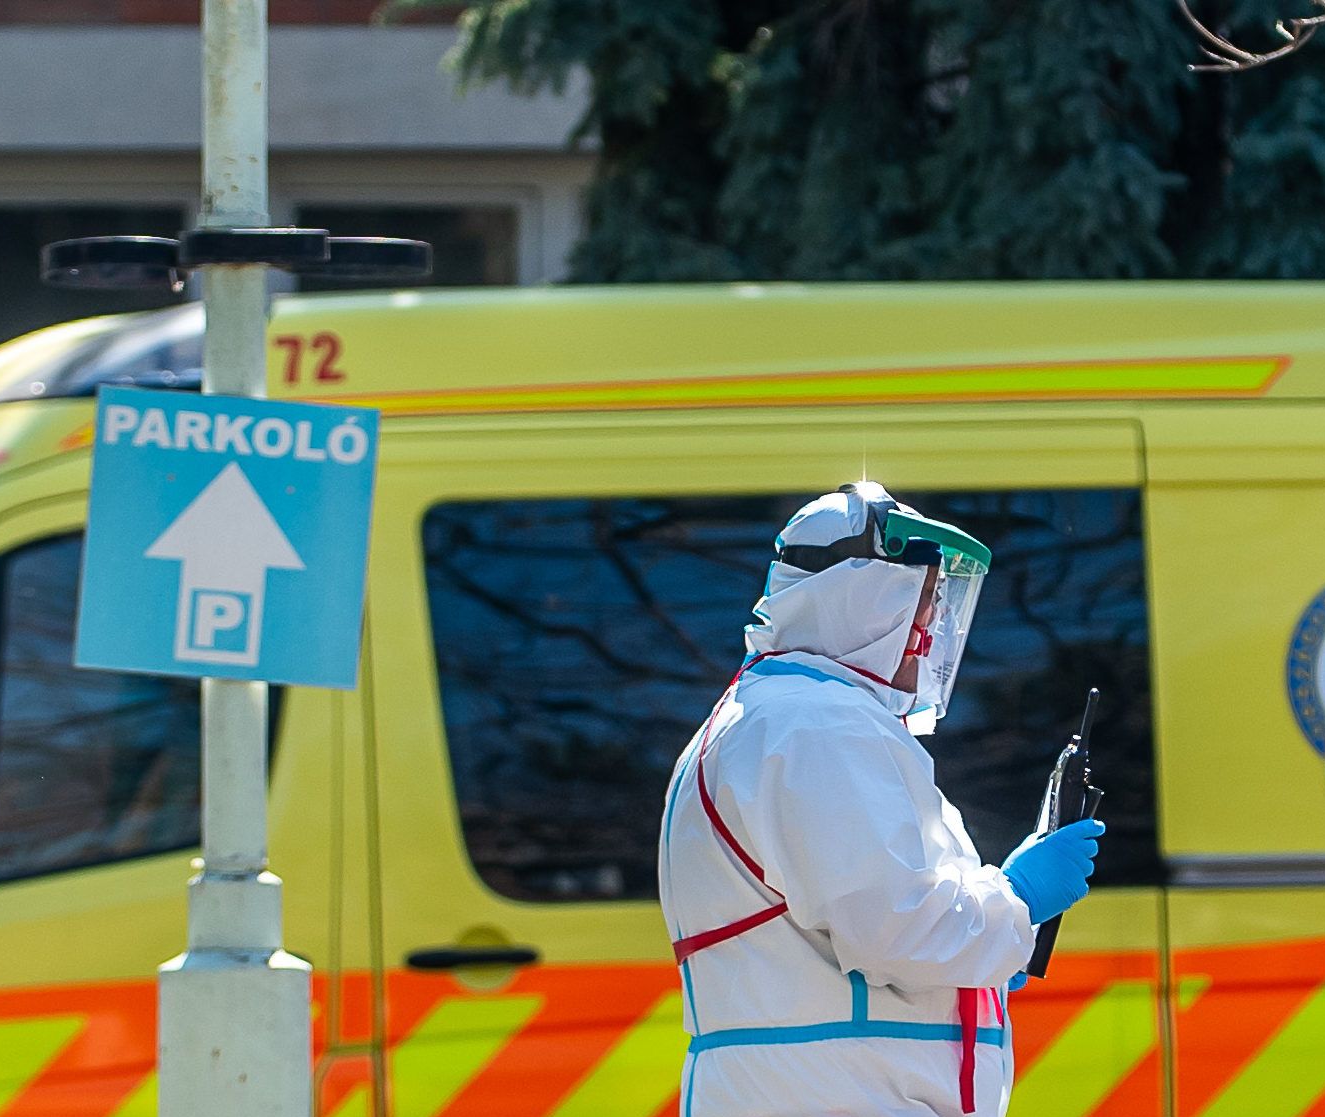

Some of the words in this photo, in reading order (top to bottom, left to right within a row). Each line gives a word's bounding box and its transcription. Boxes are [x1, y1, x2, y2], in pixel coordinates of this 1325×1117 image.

[272, 330, 347, 385] 72
[103, 404, 369, 465] PARKOLÓ
[194, 593, 245, 649] P
